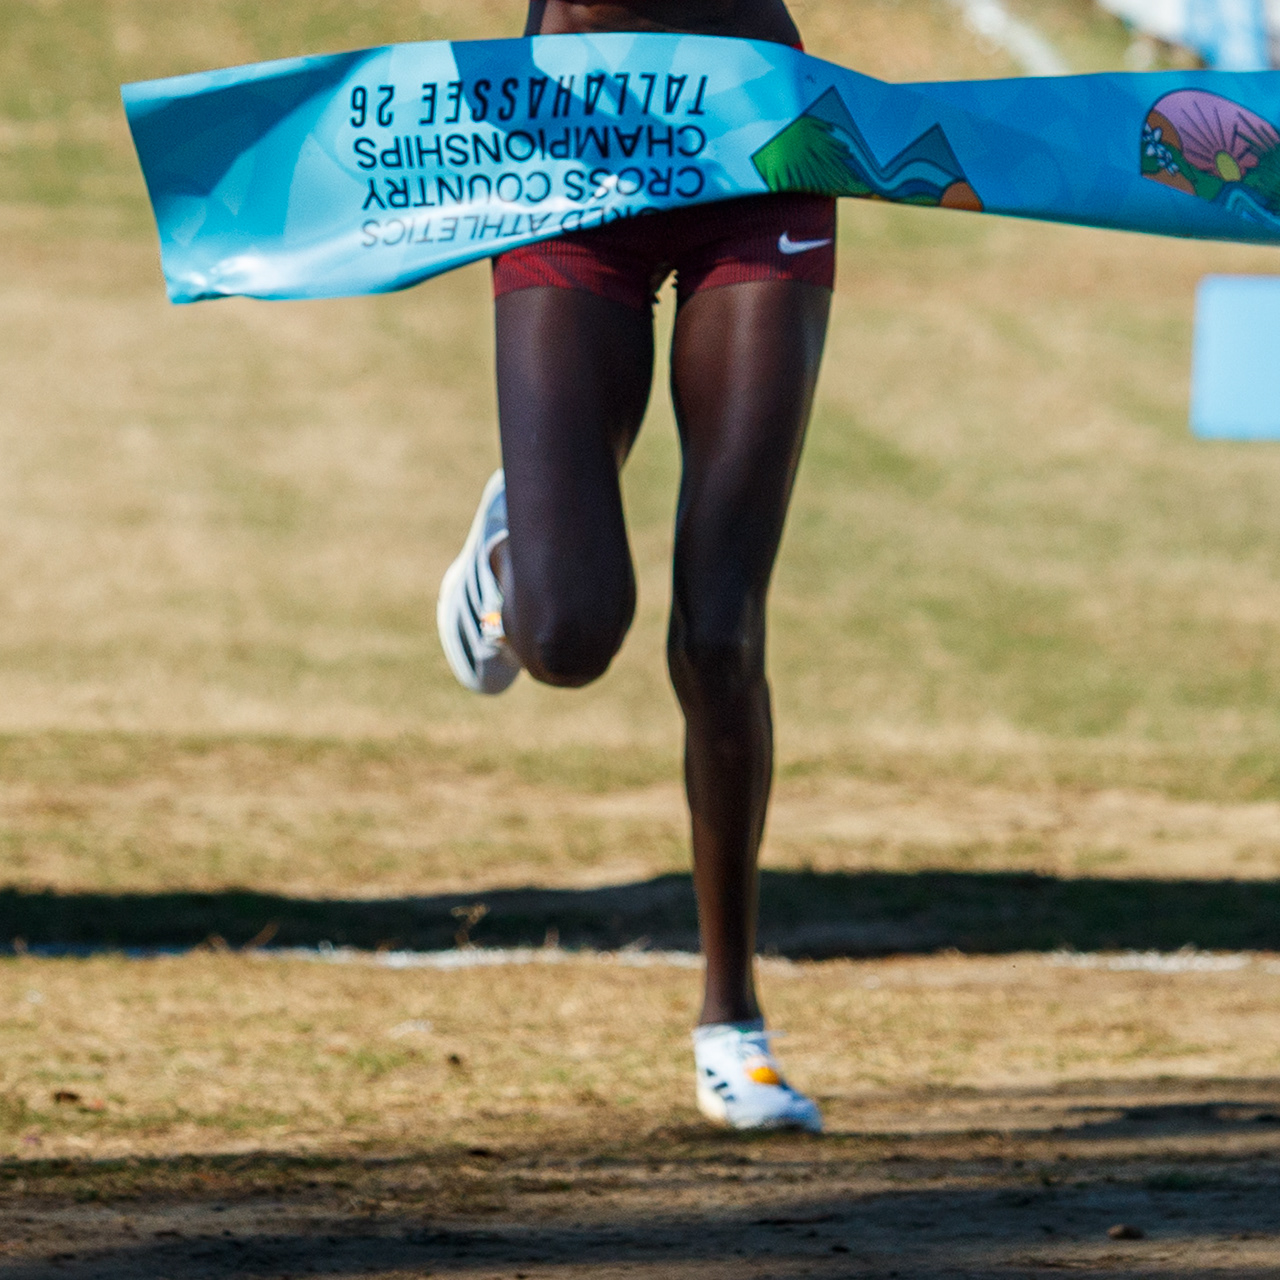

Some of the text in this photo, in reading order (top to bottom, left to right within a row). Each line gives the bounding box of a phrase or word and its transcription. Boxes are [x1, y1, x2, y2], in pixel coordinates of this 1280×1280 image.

[350, 73, 708, 129] TALLAHASSEE 26
[353, 125, 707, 169] CHAMPIONSHIPS
[362, 165, 706, 211] CROSS COUNTRY
[362, 210, 552, 247] ATHLETICS
